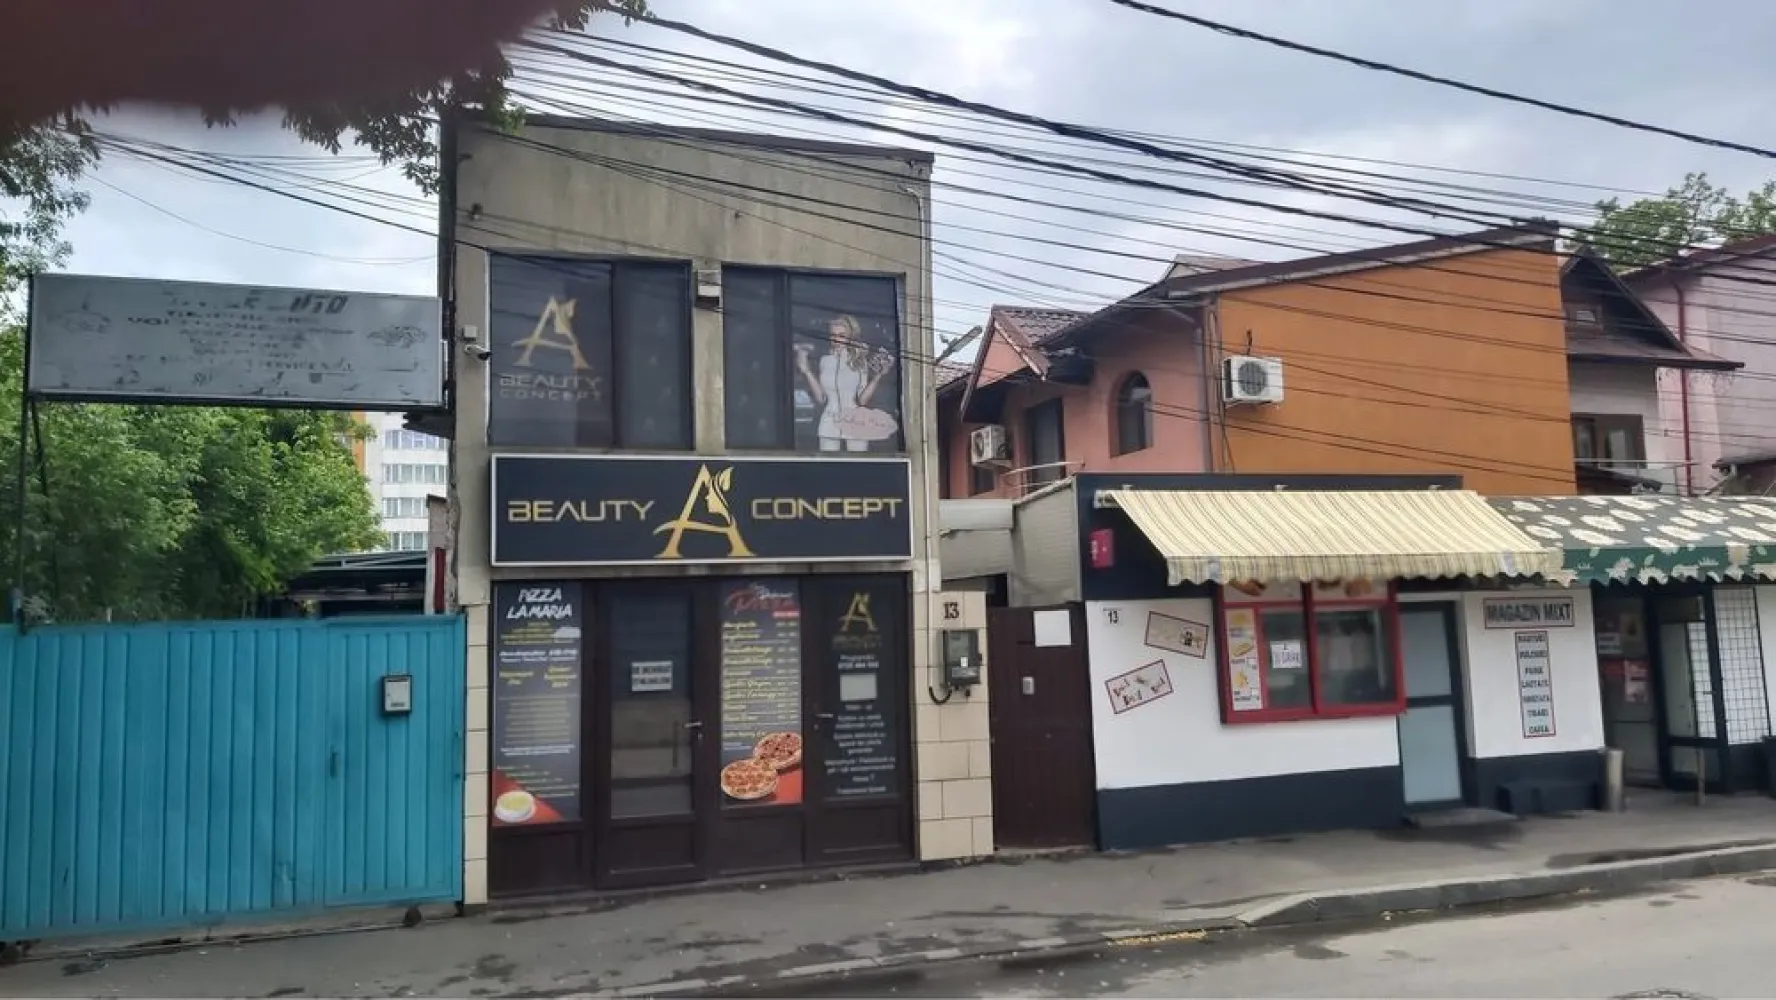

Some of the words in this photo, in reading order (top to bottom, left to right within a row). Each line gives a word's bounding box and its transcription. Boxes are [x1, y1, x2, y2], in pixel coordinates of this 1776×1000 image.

[499, 372, 603, 389] BEAUTY
[499, 388, 601, 402] CONCEPT
[507, 499, 655, 523] BEAUTY
[750, 497, 903, 521] CONCEPT
[518, 588, 562, 602] PIZZA
[943, 601, 960, 619] 13
[1107, 610, 1120, 625] 13
[1487, 603, 1541, 621] MAGAZIN
[1543, 603, 1571, 621] MIXT
